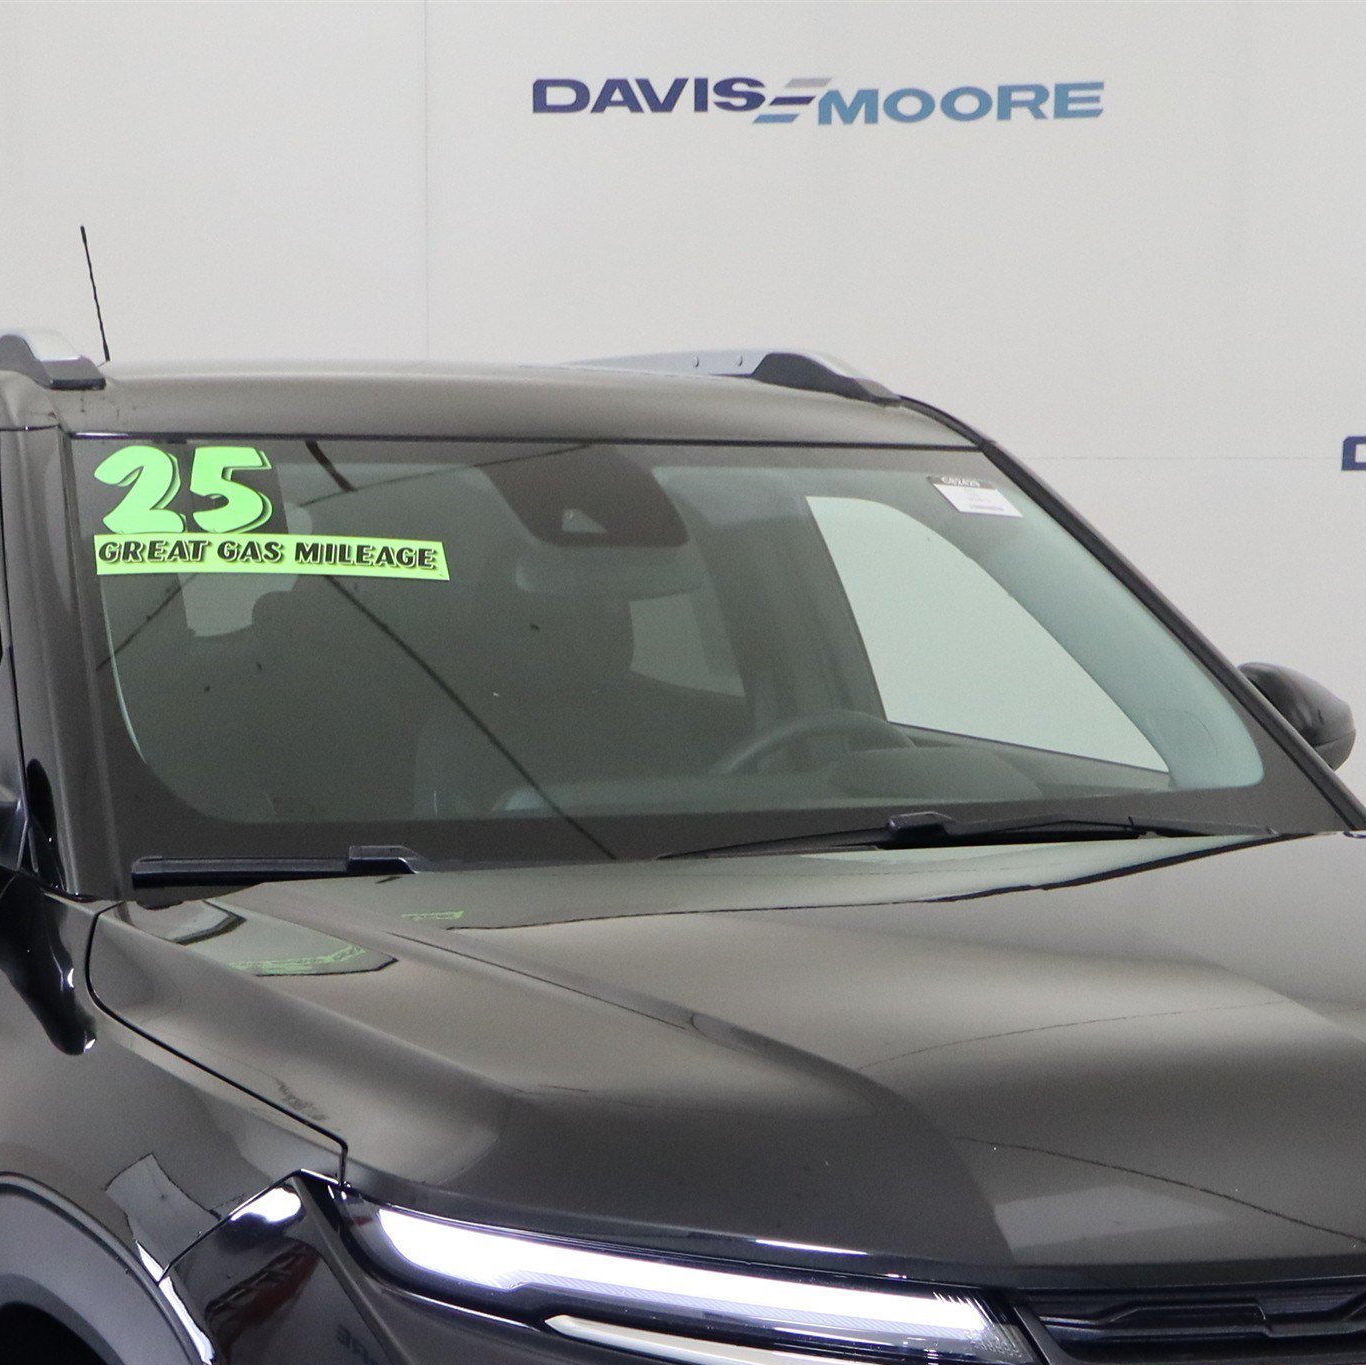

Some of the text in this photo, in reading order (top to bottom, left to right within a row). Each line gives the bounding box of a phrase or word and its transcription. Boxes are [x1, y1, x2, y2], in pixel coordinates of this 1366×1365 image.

[532, 77, 1105, 126] DAVIS MOORE
[93, 445, 273, 534] 25
[98, 540, 436, 569] GREAT GAS MILEAGE
